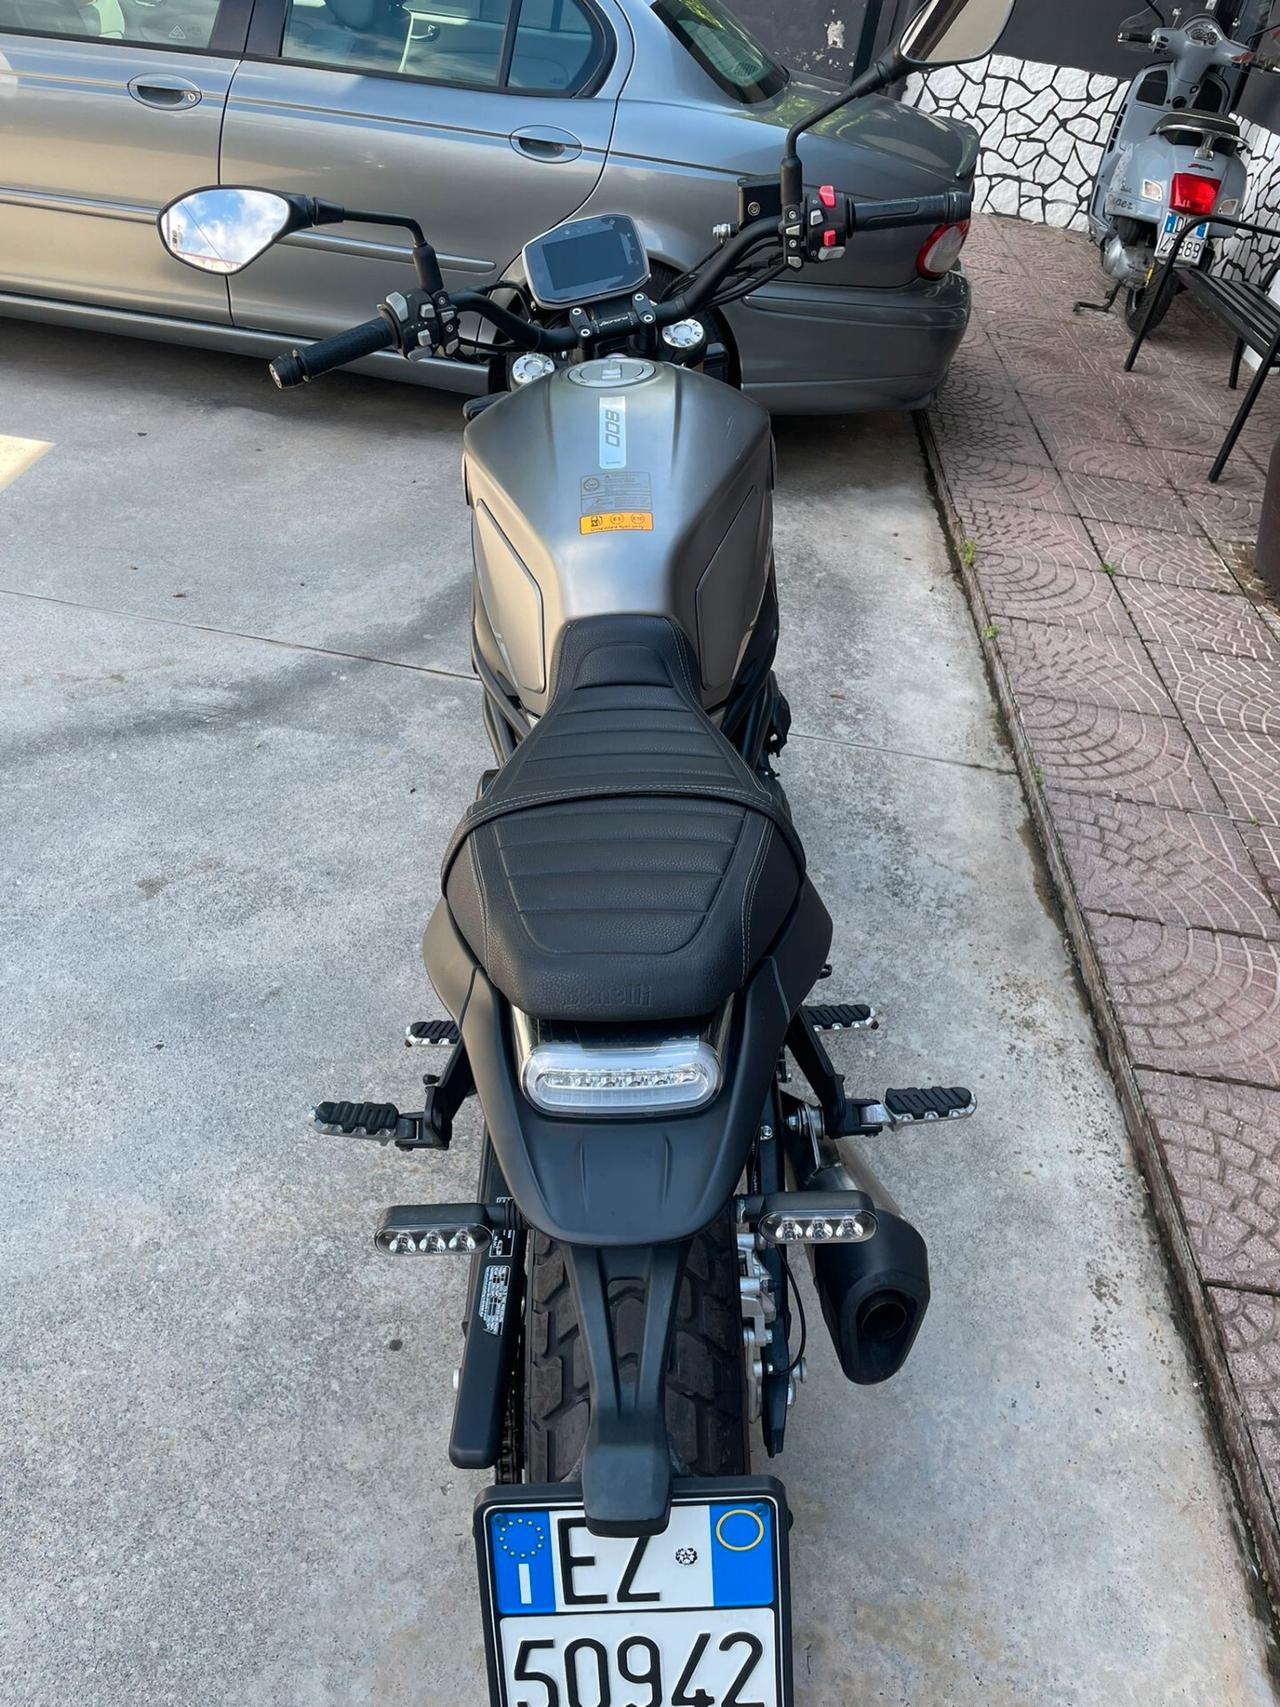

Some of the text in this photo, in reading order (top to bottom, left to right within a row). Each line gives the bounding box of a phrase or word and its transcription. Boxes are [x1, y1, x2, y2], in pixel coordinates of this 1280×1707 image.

[605, 409, 620, 447] 800
[557, 1517, 661, 1605] EZ
[514, 1631, 765, 1707] 50942
